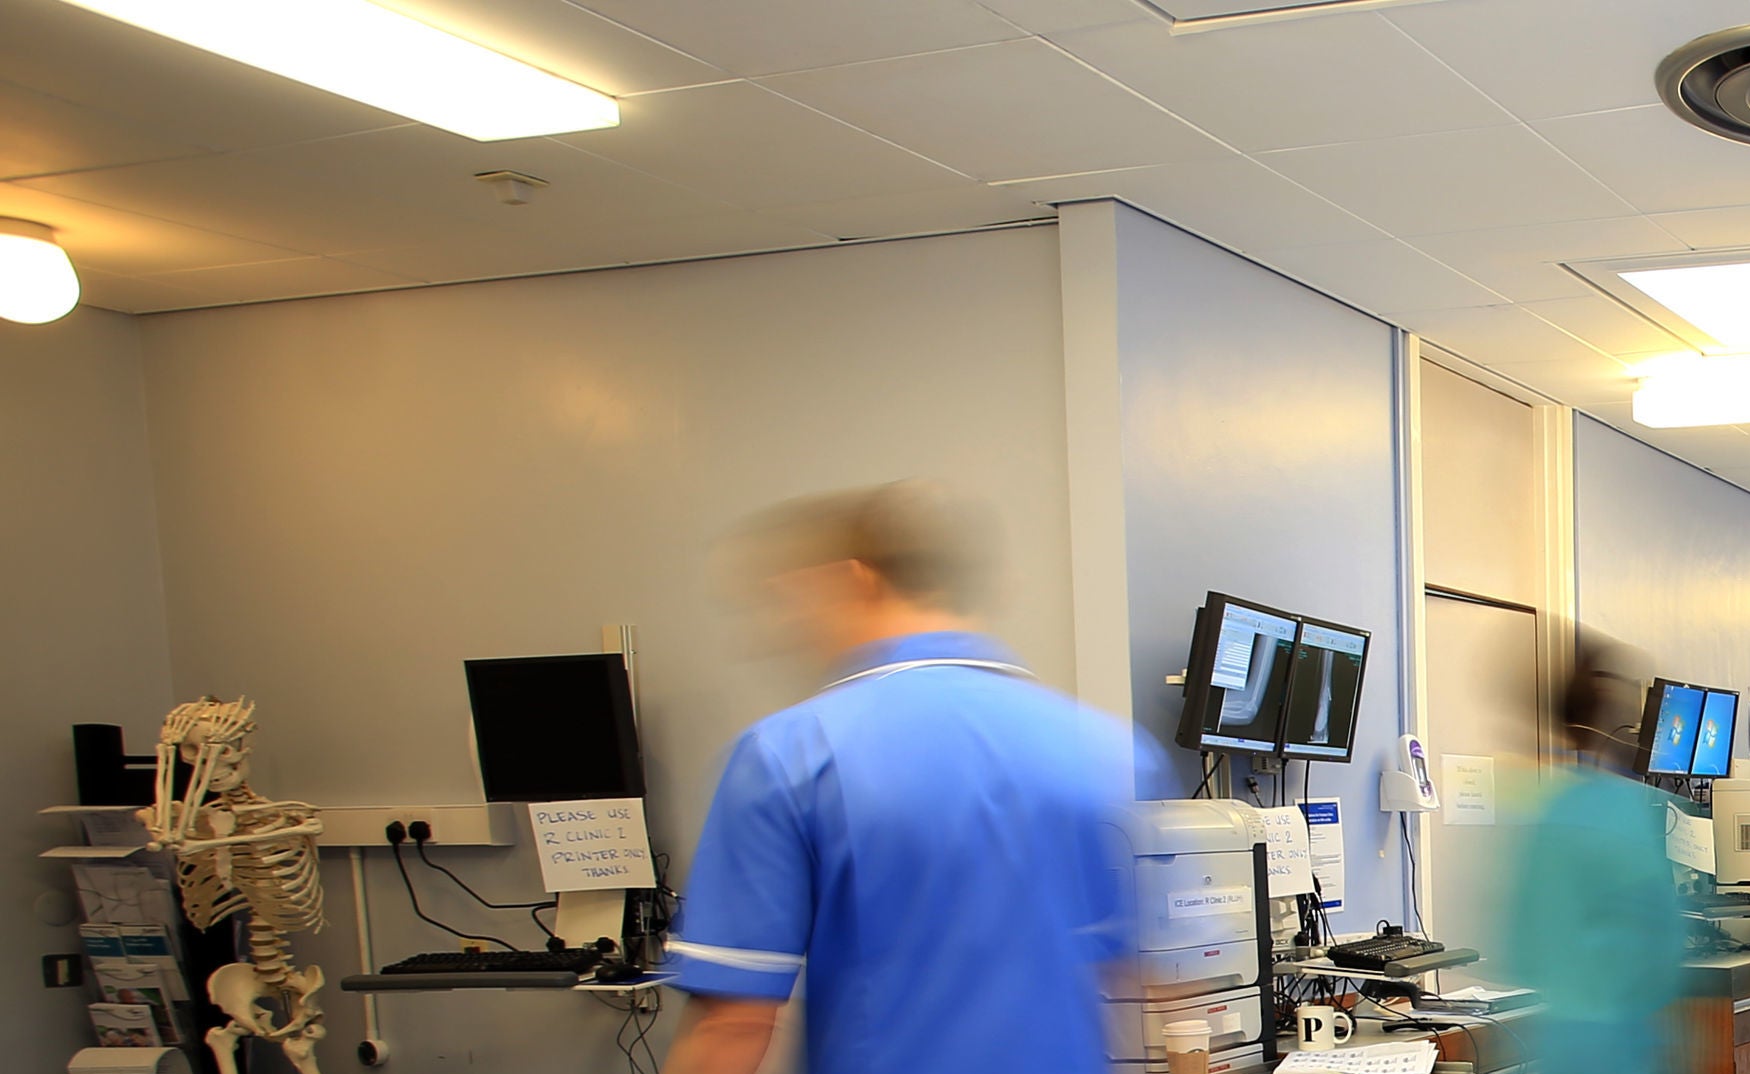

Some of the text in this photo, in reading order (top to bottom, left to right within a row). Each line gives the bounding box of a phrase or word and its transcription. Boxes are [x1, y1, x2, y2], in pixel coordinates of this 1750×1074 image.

[536, 808, 631, 825] PLEASE USE
[1275, 815, 1291, 825] USE
[566, 828, 611, 842] CLINIC
[1285, 831, 1293, 844] 2
[551, 848, 646, 864] PRINTER ONLY
[1289, 849, 1308, 859] ONLY
[581, 865, 629, 878] THANKS
[1268, 866, 1291, 876] ANKS
[1301, 1017, 1323, 1042] P
